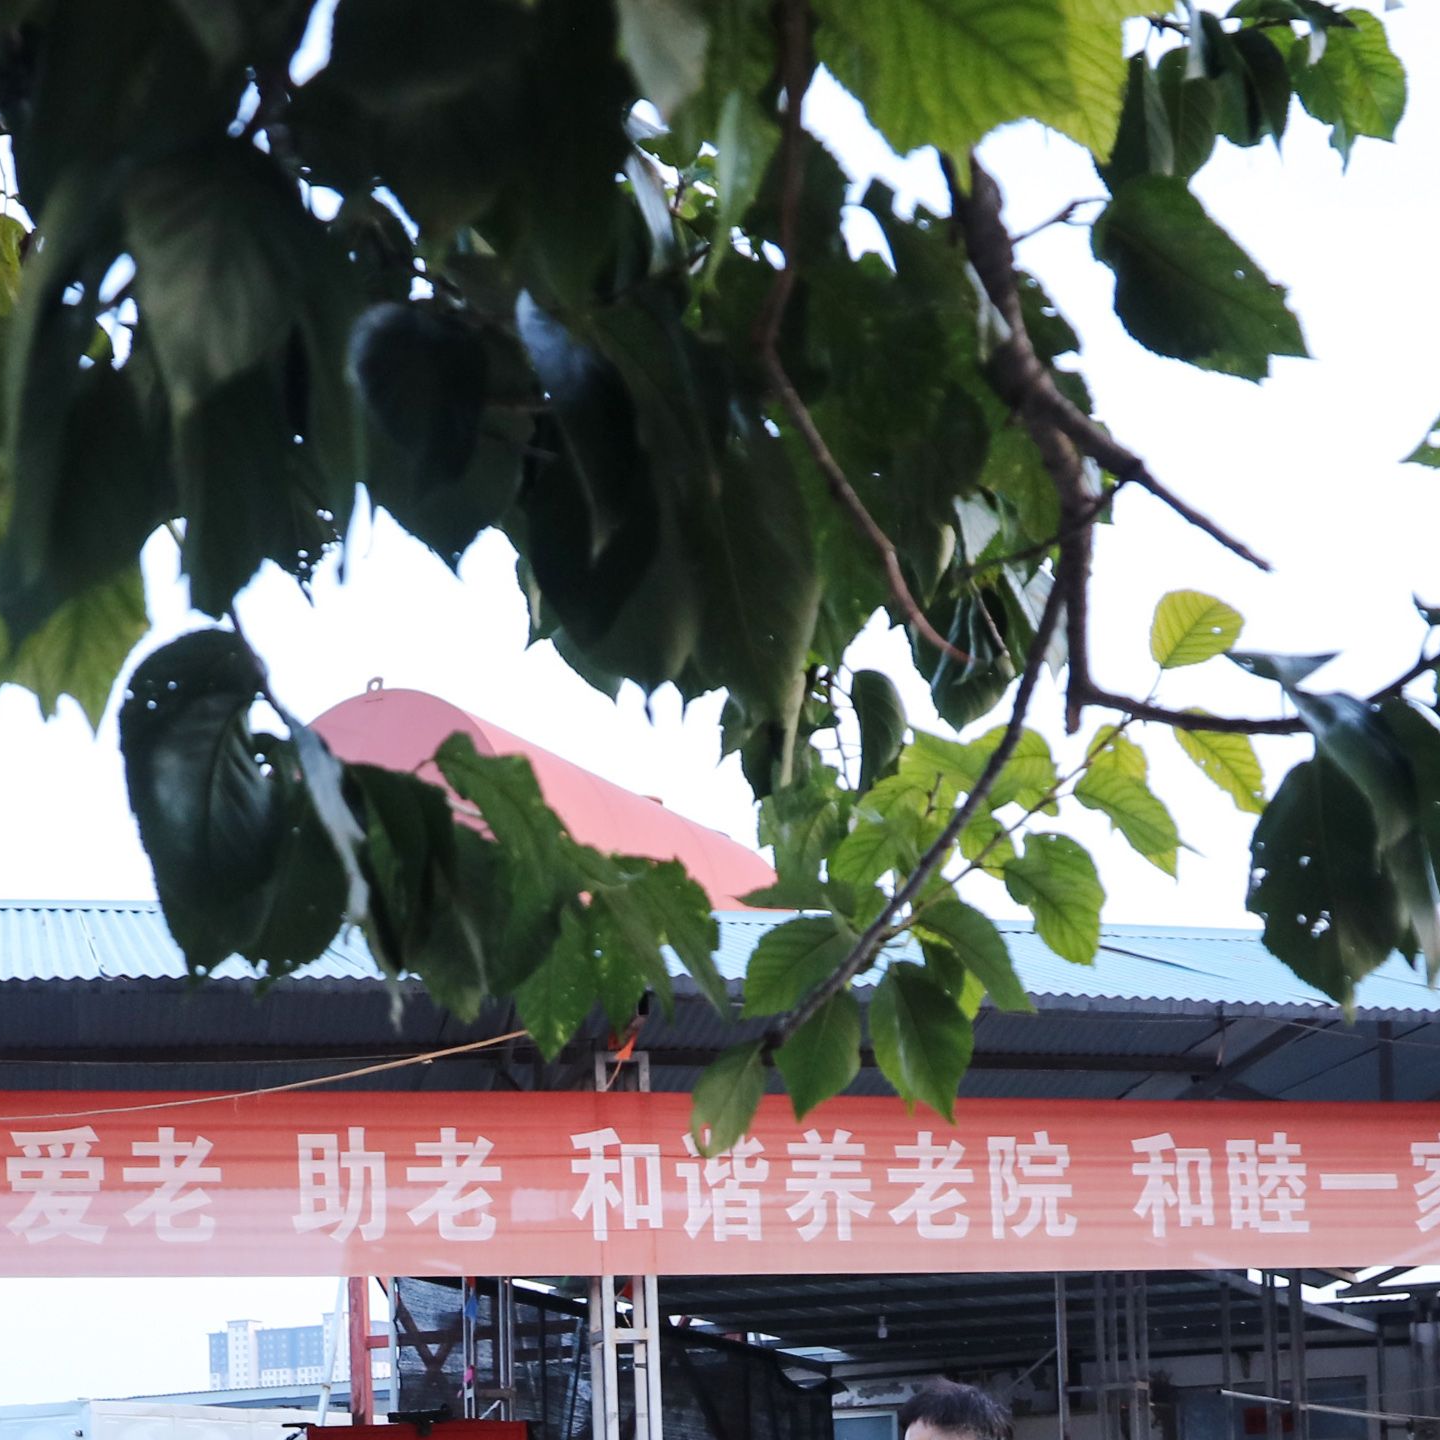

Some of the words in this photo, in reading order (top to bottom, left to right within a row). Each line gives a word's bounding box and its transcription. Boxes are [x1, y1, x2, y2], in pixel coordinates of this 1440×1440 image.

[5, 1123, 224, 1245] 爱老
[292, 1124, 502, 1243] 助老
[570, 1125, 1077, 1242] 和谐养老院
